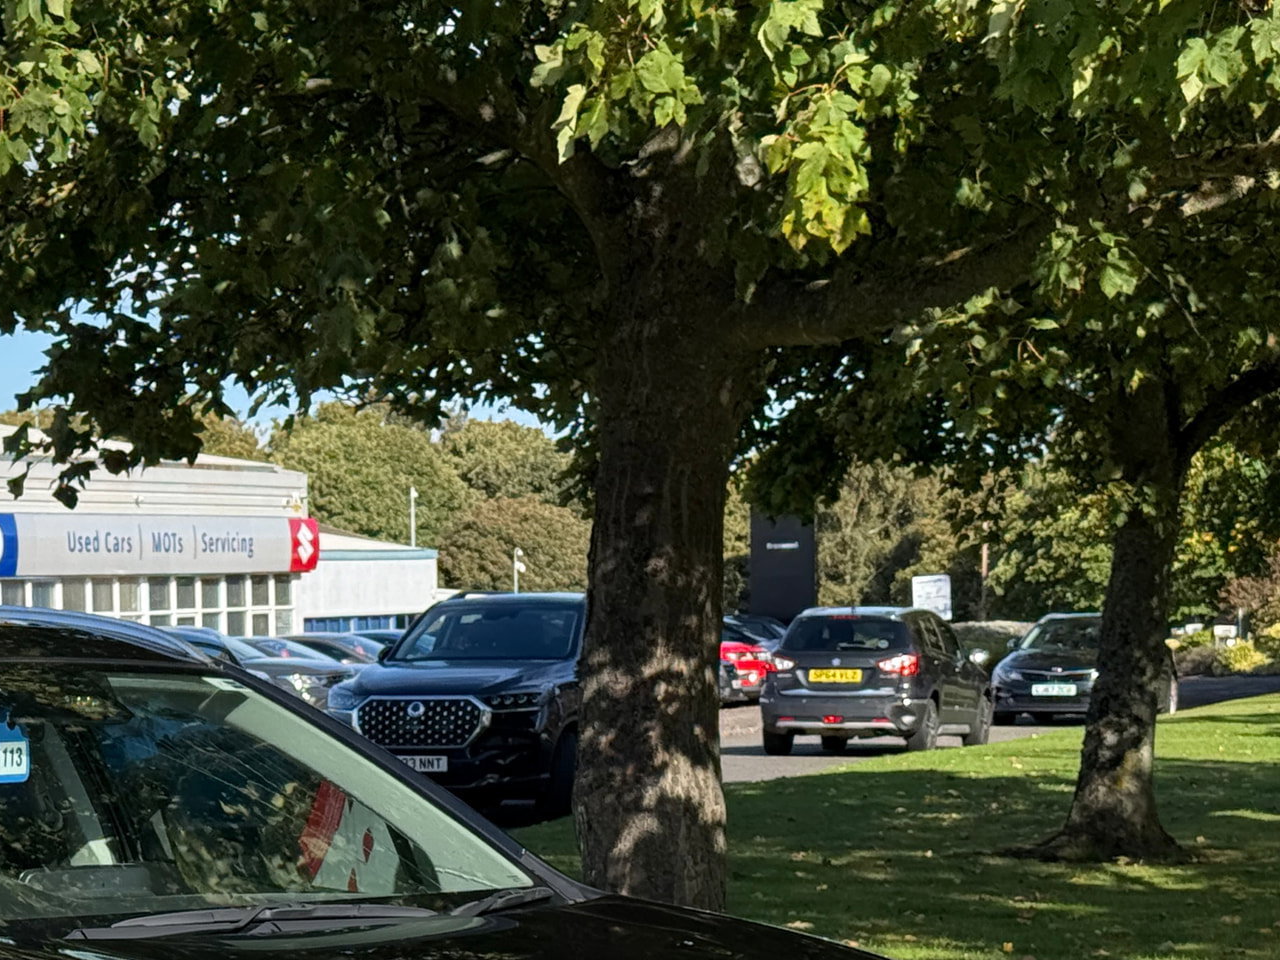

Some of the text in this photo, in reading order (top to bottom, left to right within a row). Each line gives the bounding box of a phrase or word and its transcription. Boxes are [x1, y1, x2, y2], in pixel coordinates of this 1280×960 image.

[67, 530, 133, 553] Used Cars
[152, 531, 184, 553] MOTs
[201, 531, 255, 558] Servicing
[2, 746, 23, 768] 113
[419, 757, 443, 769] NNT
